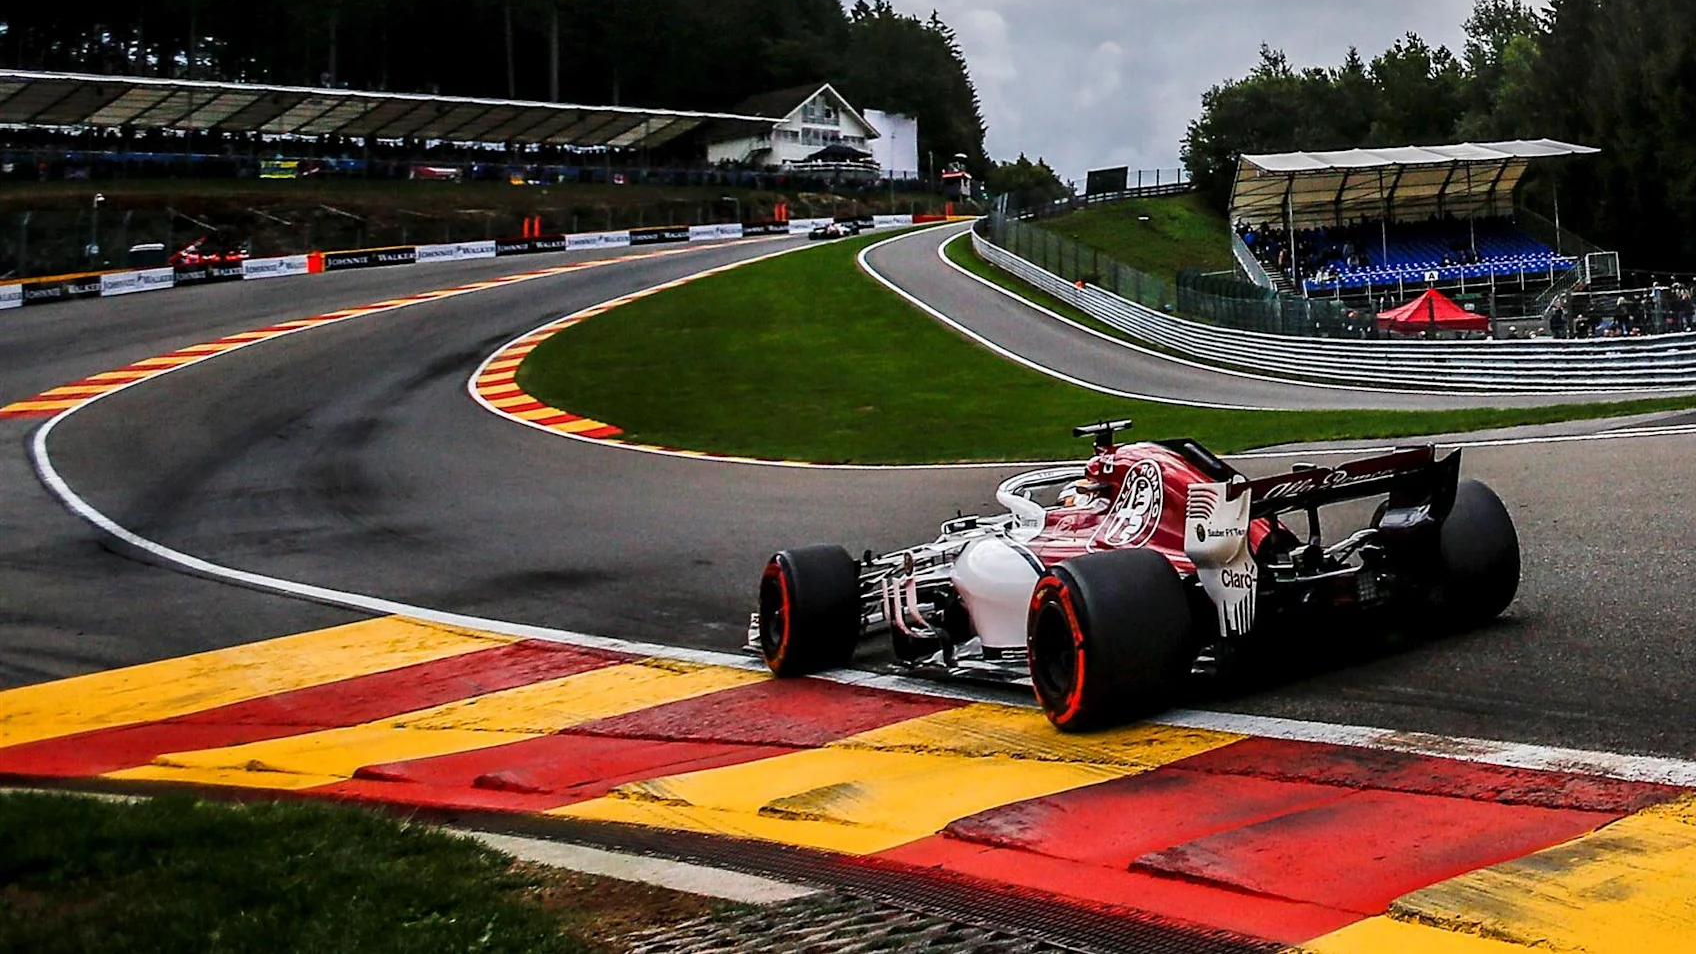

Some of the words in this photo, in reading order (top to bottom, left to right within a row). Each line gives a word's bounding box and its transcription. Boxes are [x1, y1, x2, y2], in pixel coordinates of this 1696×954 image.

[327, 257, 369, 268] JOHNNIE
[378, 252, 417, 262] WALKER
[1428, 272, 1436, 280] A
[1115, 469, 1138, 513] ALFA
[1140, 464, 1160, 519] ROMEO
[1263, 478, 1316, 500] Alfa
[1221, 568, 1253, 589] Claro
